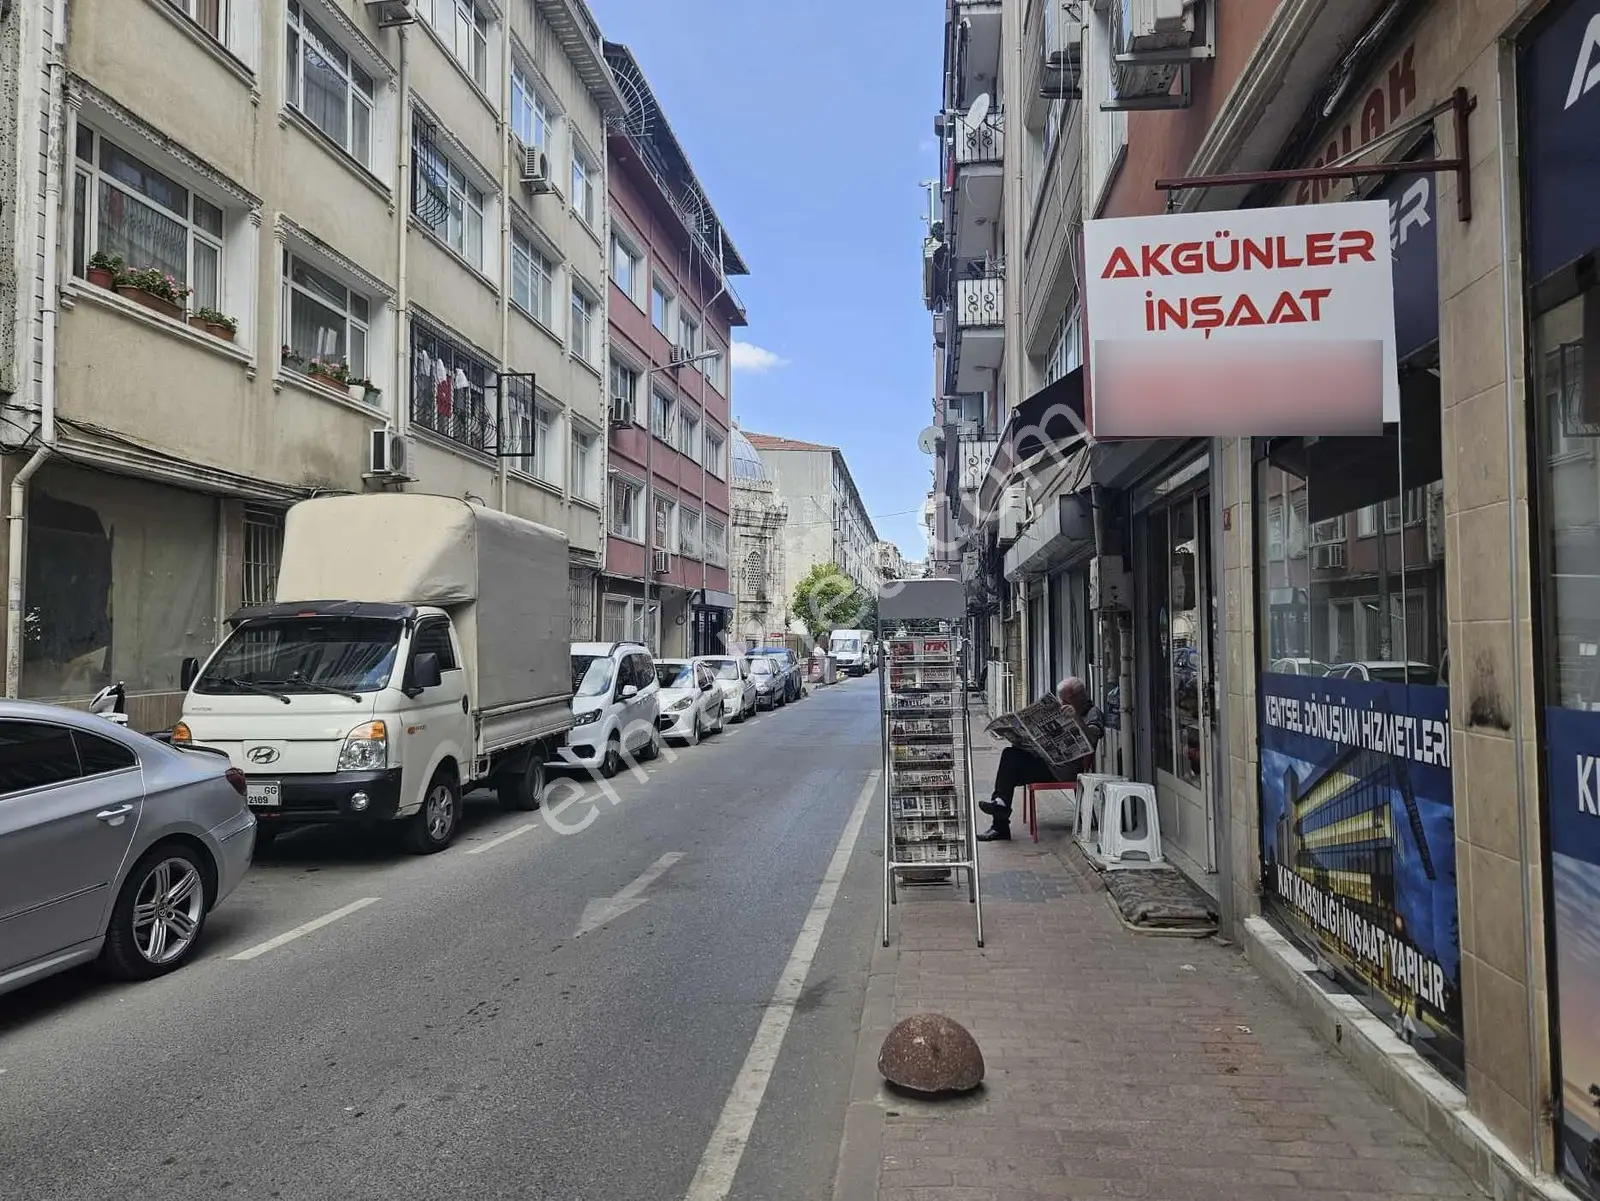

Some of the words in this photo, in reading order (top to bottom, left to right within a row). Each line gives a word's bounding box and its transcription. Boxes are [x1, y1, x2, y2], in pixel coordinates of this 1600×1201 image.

[1100, 230, 1377, 279] AKGÜNLER
[1145, 288, 1332, 340] İNŞAAT
[1265, 695, 1303, 733] KENTSEL
[1304, 693, 1360, 755] DÖNÜŞÜM
[1361, 701, 1450, 768] HİZMETLERİ
[1278, 864, 1293, 902] KAT
[1342, 898, 1385, 968] İNŞAAT
[1388, 933, 1446, 1012] YAPILIR
